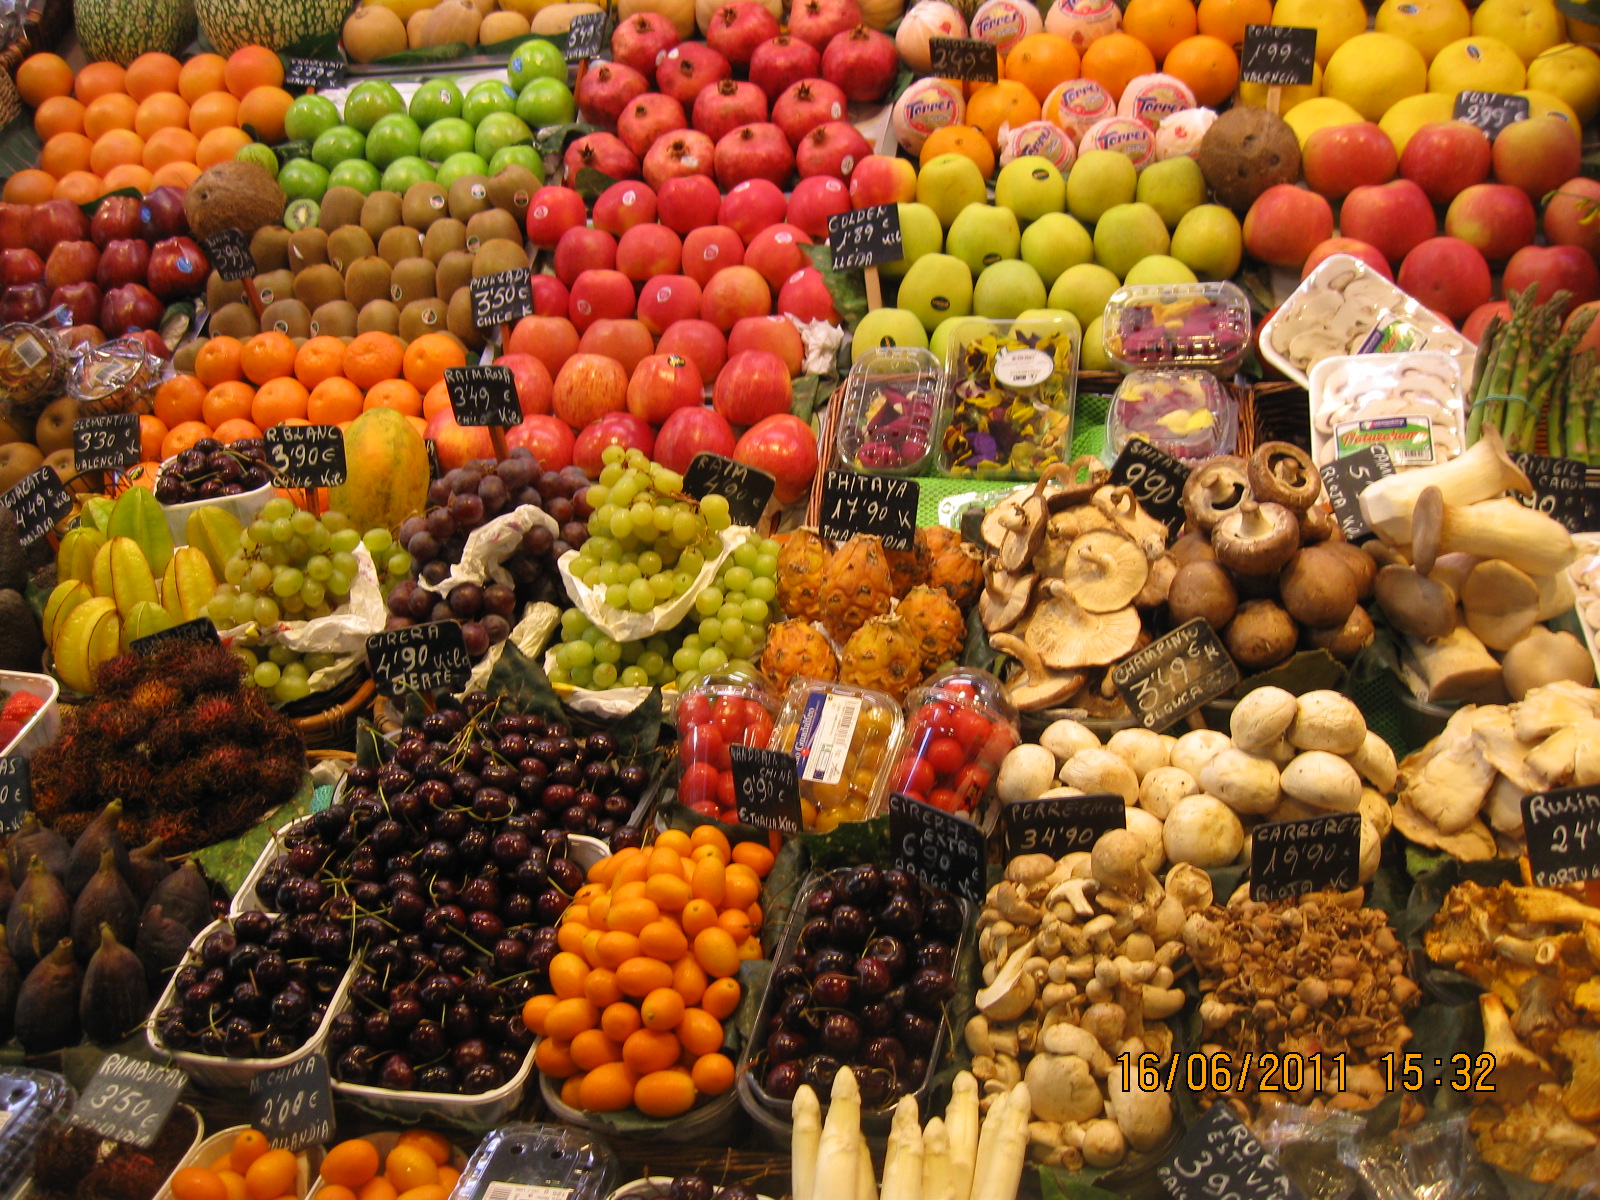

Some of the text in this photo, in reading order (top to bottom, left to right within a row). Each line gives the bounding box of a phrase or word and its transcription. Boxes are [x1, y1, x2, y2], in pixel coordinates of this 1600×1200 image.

[1247, 43, 1292, 68] 1'99
[1097, 131, 1148, 150] Torres
[828, 205, 887, 233] GOLDEN
[836, 223, 874, 252] 1'89
[211, 245, 244, 269] 3'99
[475, 284, 516, 316] 3'50
[454, 383, 490, 410] 3'49
[78, 431, 116, 453] 3'30
[283, 425, 339, 443] BLANC
[75, 451, 124, 470] VALENCIA
[271, 443, 319, 473] 3'90
[828, 471, 908, 500] PHITAYA
[1126, 463, 1175, 504] 9'90
[15, 493, 46, 529] 4'49
[831, 497, 888, 525] 17'90
[368, 624, 439, 649] CIRERA
[376, 644, 428, 680] 4'90
[742, 774, 774, 802] 9'90
[924, 828, 978, 861] EXTRA
[1020, 826, 1094, 850] 34'90
[1263, 842, 1337, 876] 19'90
[99, 1053, 188, 1089] RAMBUTAN
[266, 1056, 316, 1086] CHINA
[91, 1083, 150, 1118] 3'50
